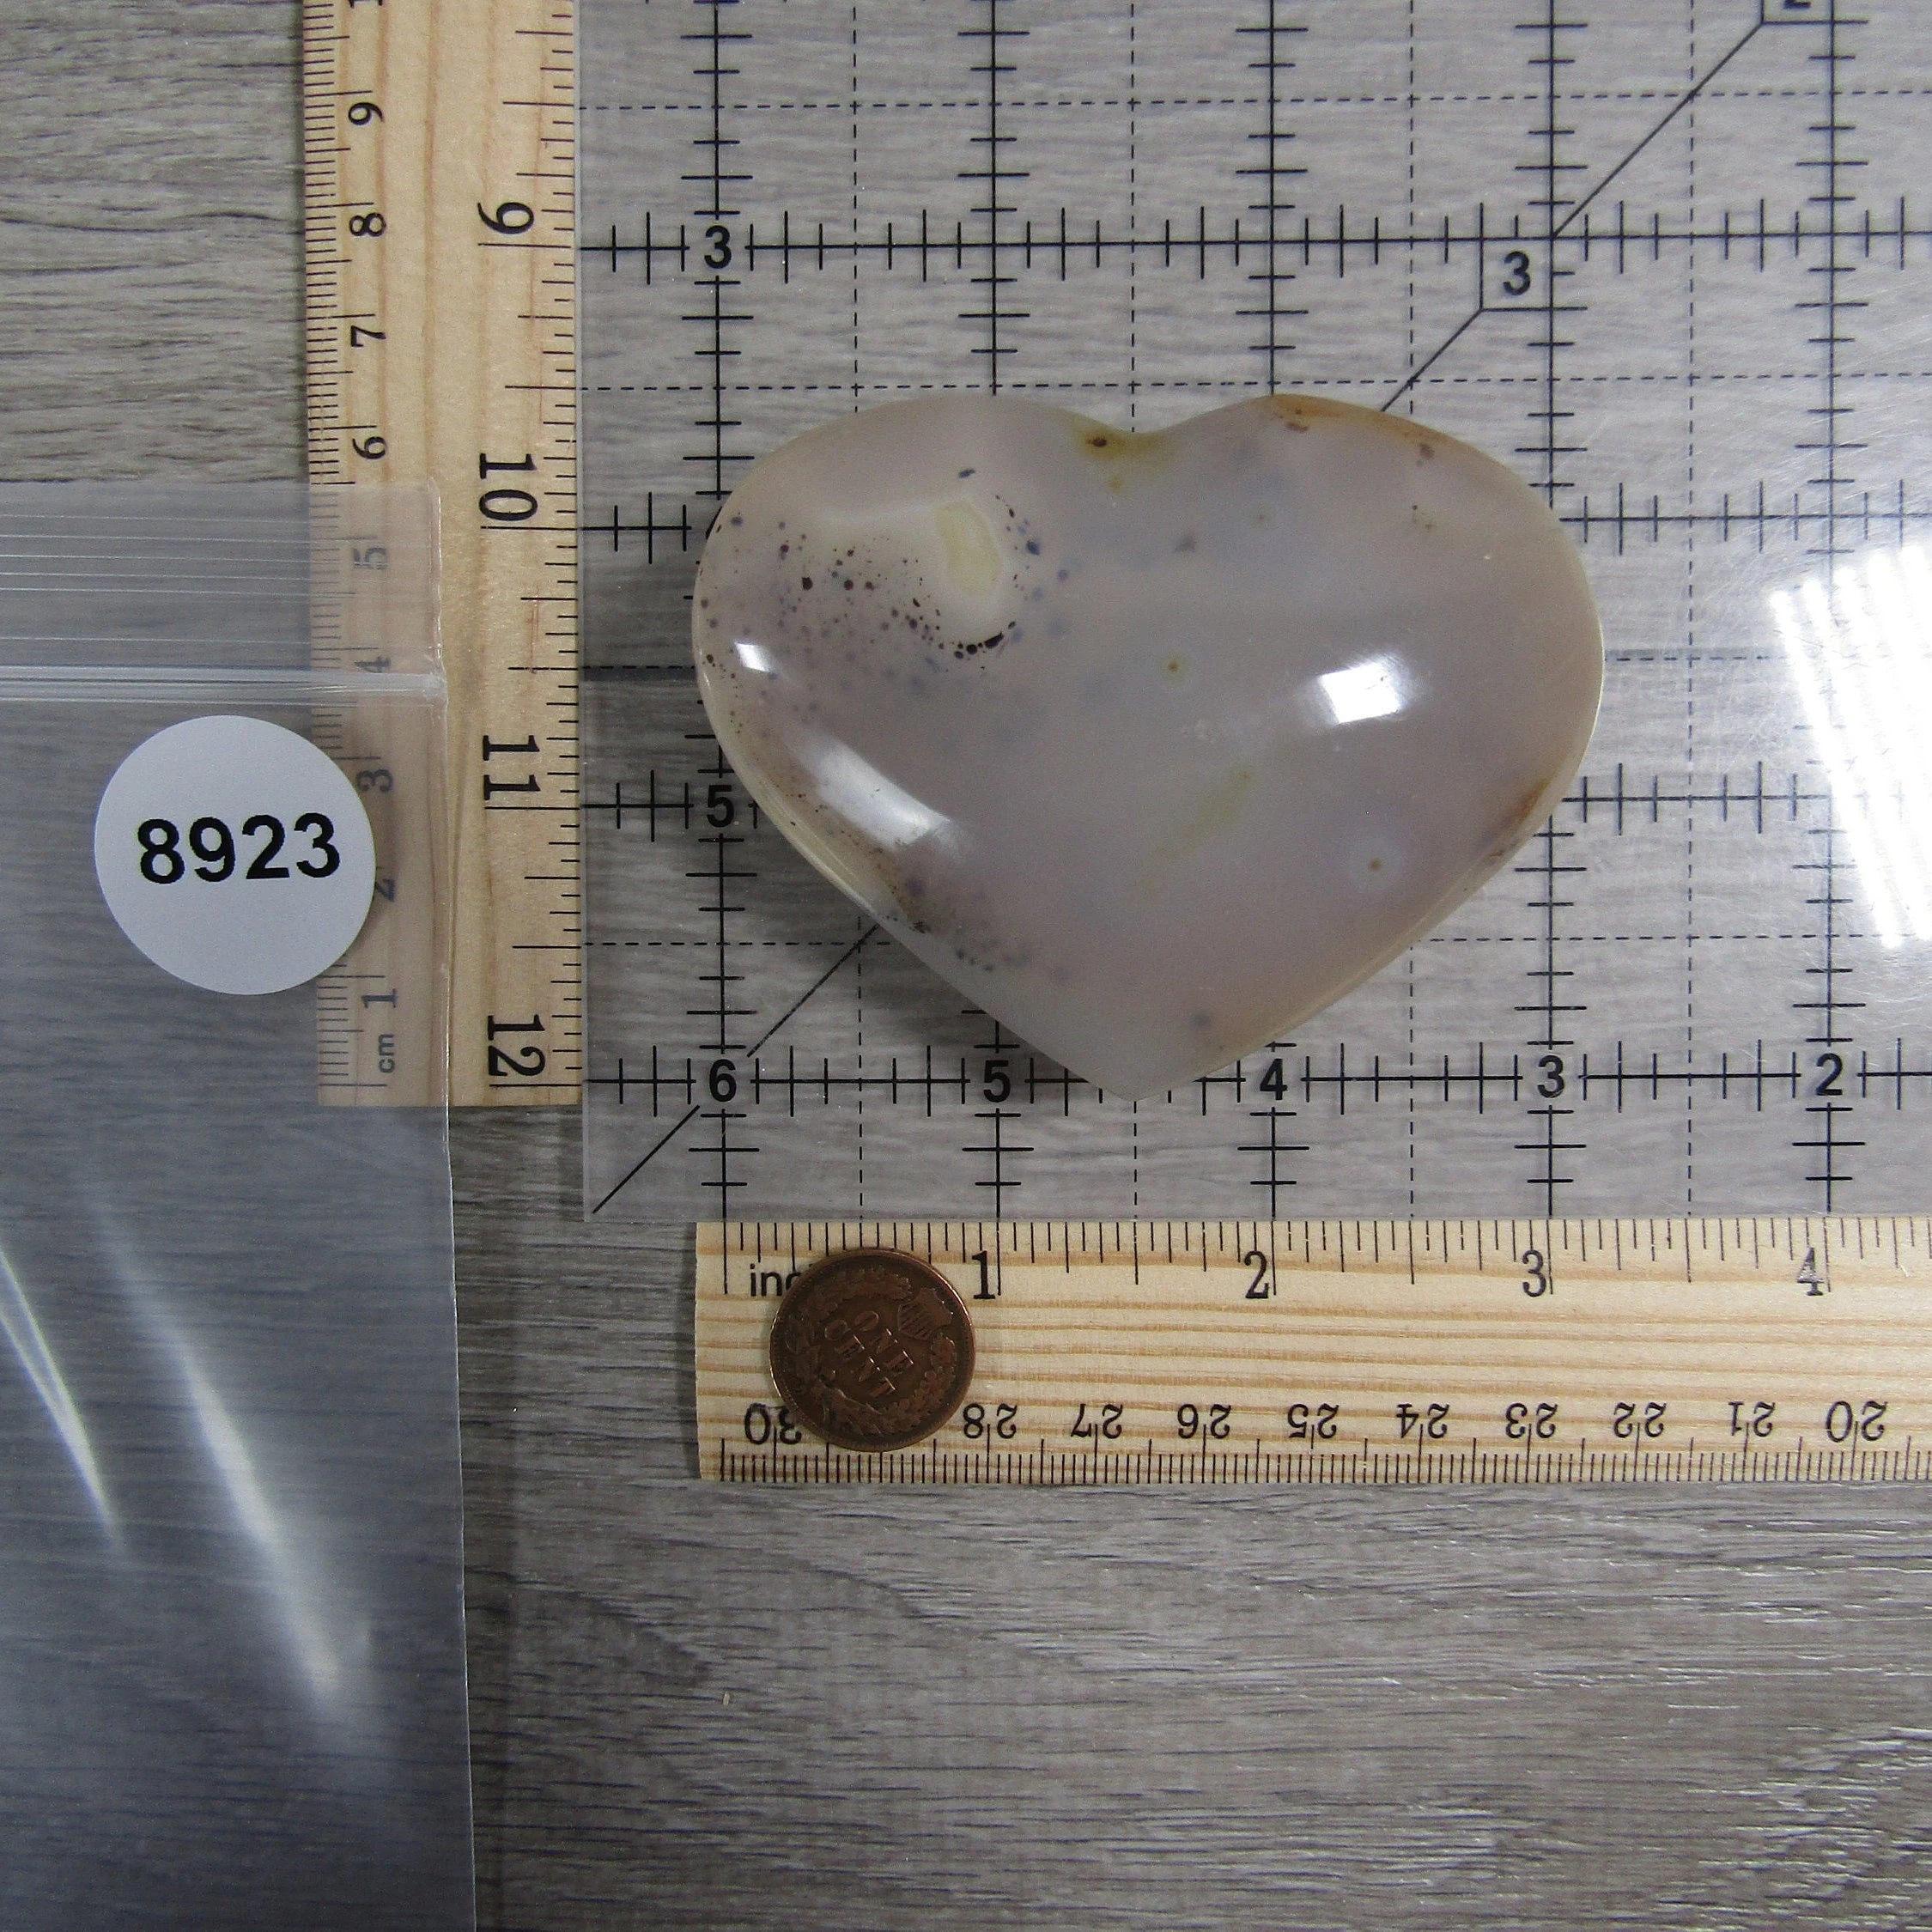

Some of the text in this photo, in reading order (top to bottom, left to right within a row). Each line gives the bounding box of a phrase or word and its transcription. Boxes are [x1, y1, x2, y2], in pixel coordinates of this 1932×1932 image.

[348, 101, 384, 125] 9
[349, 212, 386, 237] 8
[477, 202, 534, 234] 9
[703, 224, 732, 269] 3
[1503, 250, 1531, 296] 3
[350, 325, 386, 348] 7
[352, 435, 386, 460] 6
[478, 453, 538, 521] 10
[352, 546, 386, 570] 5
[355, 769, 393, 793] 3
[482, 734, 541, 801] 11
[706, 784, 735, 828] 5
[137, 812, 341, 884] 8923
[361, 988, 398, 1009] 1
[378, 1033, 395, 1074] cm
[487, 1014, 546, 1077] 12
[708, 1058, 738, 1103] 6
[982, 1059, 1012, 1103] 5
[1259, 1057, 1288, 1102] 4
[1537, 1054, 1565, 1098] 3
[1814, 1052, 1844, 1096] 2
[750, 1263, 812, 1297] inc
[971, 1250, 996, 1299] 1
[1244, 1250, 1270, 1300] 2
[1522, 1249, 1546, 1297] 3
[1796, 1247, 1826, 1297] 4
[744, 1402, 803, 1445] 30
[963, 1403, 1018, 1440] 28
[1070, 1403, 1123, 1439] 27
[1177, 1403, 1232, 1439] 26
[1287, 1403, 1340, 1439] 25
[1394, 1402, 1450, 1439] 24
[1504, 1401, 1558, 1439] 23
[1613, 1401, 1668, 1438] 22
[1728, 1400, 1777, 1438] 21
[1826, 1400, 1889, 1443] 20
